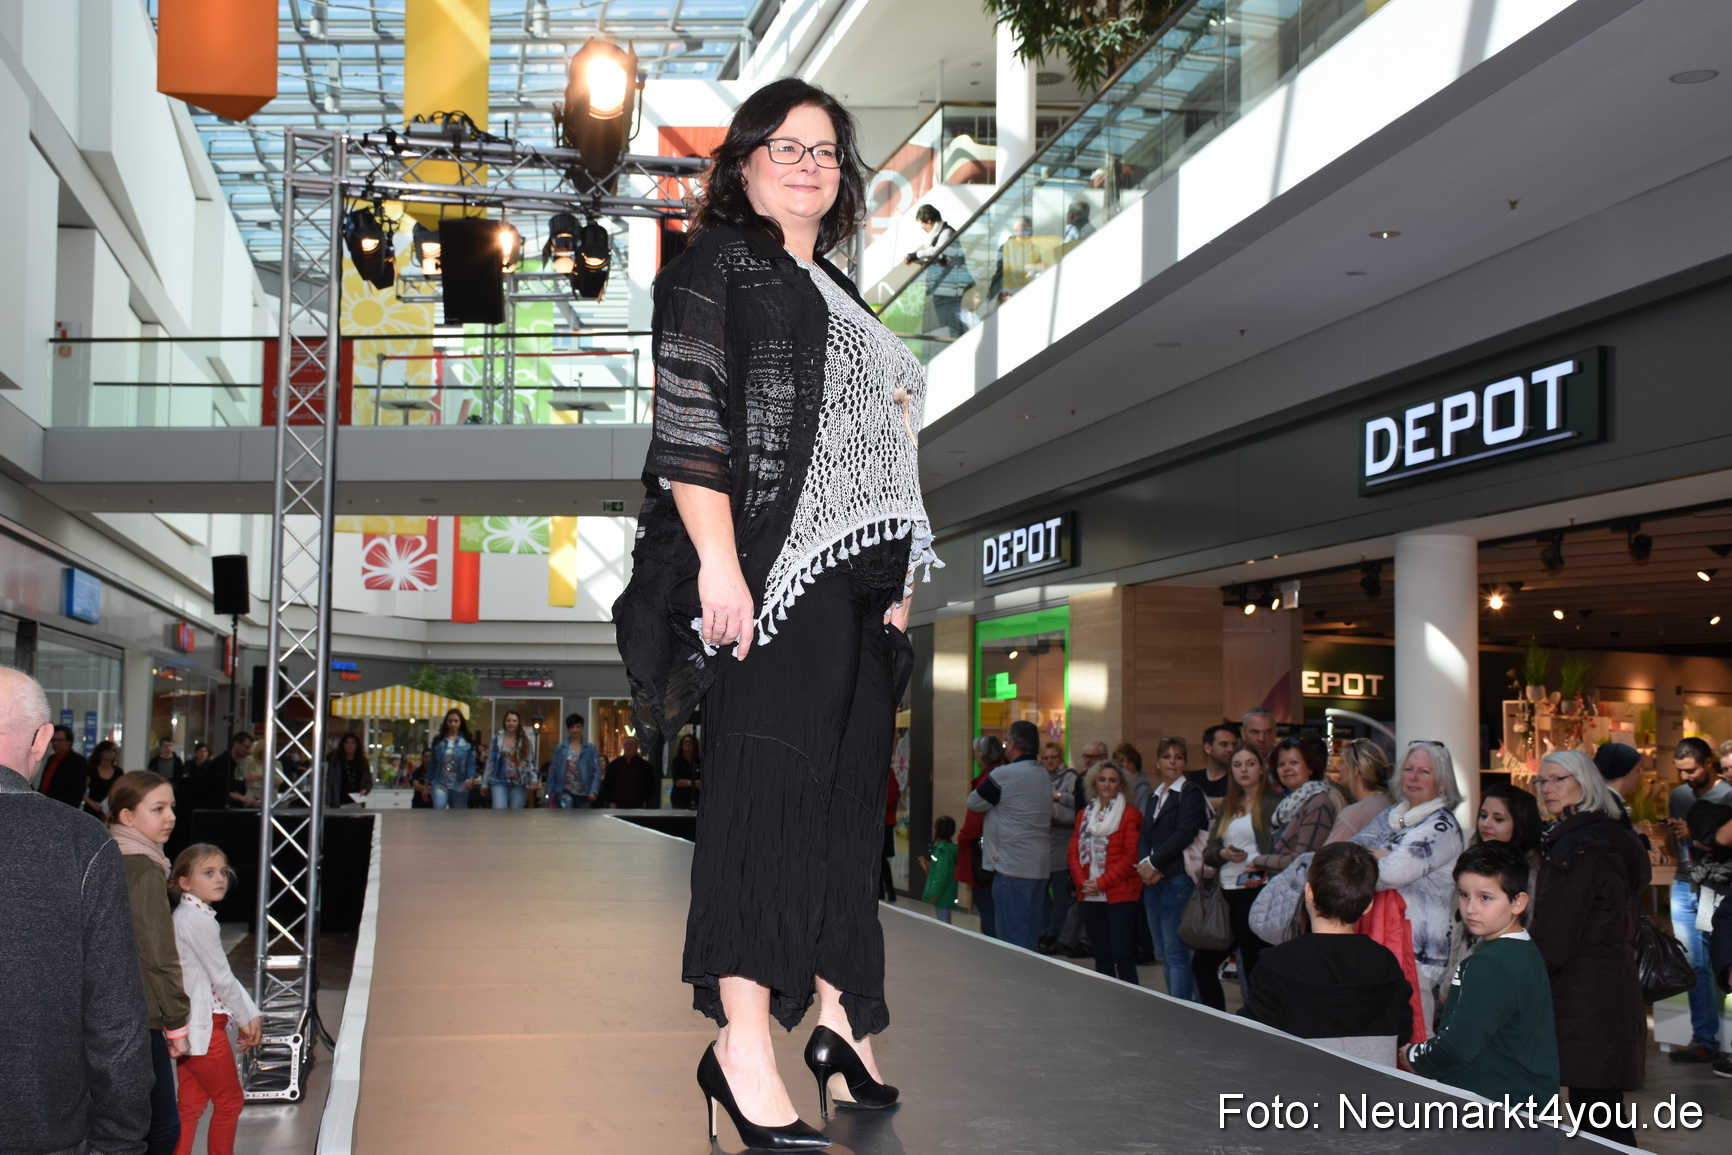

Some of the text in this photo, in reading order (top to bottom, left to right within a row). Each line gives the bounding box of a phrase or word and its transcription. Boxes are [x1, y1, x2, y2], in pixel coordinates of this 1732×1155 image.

[1366, 360, 1575, 477] DEPOT
[983, 517, 1063, 575] DEPOT
[1301, 670, 1385, 696] EPOT
